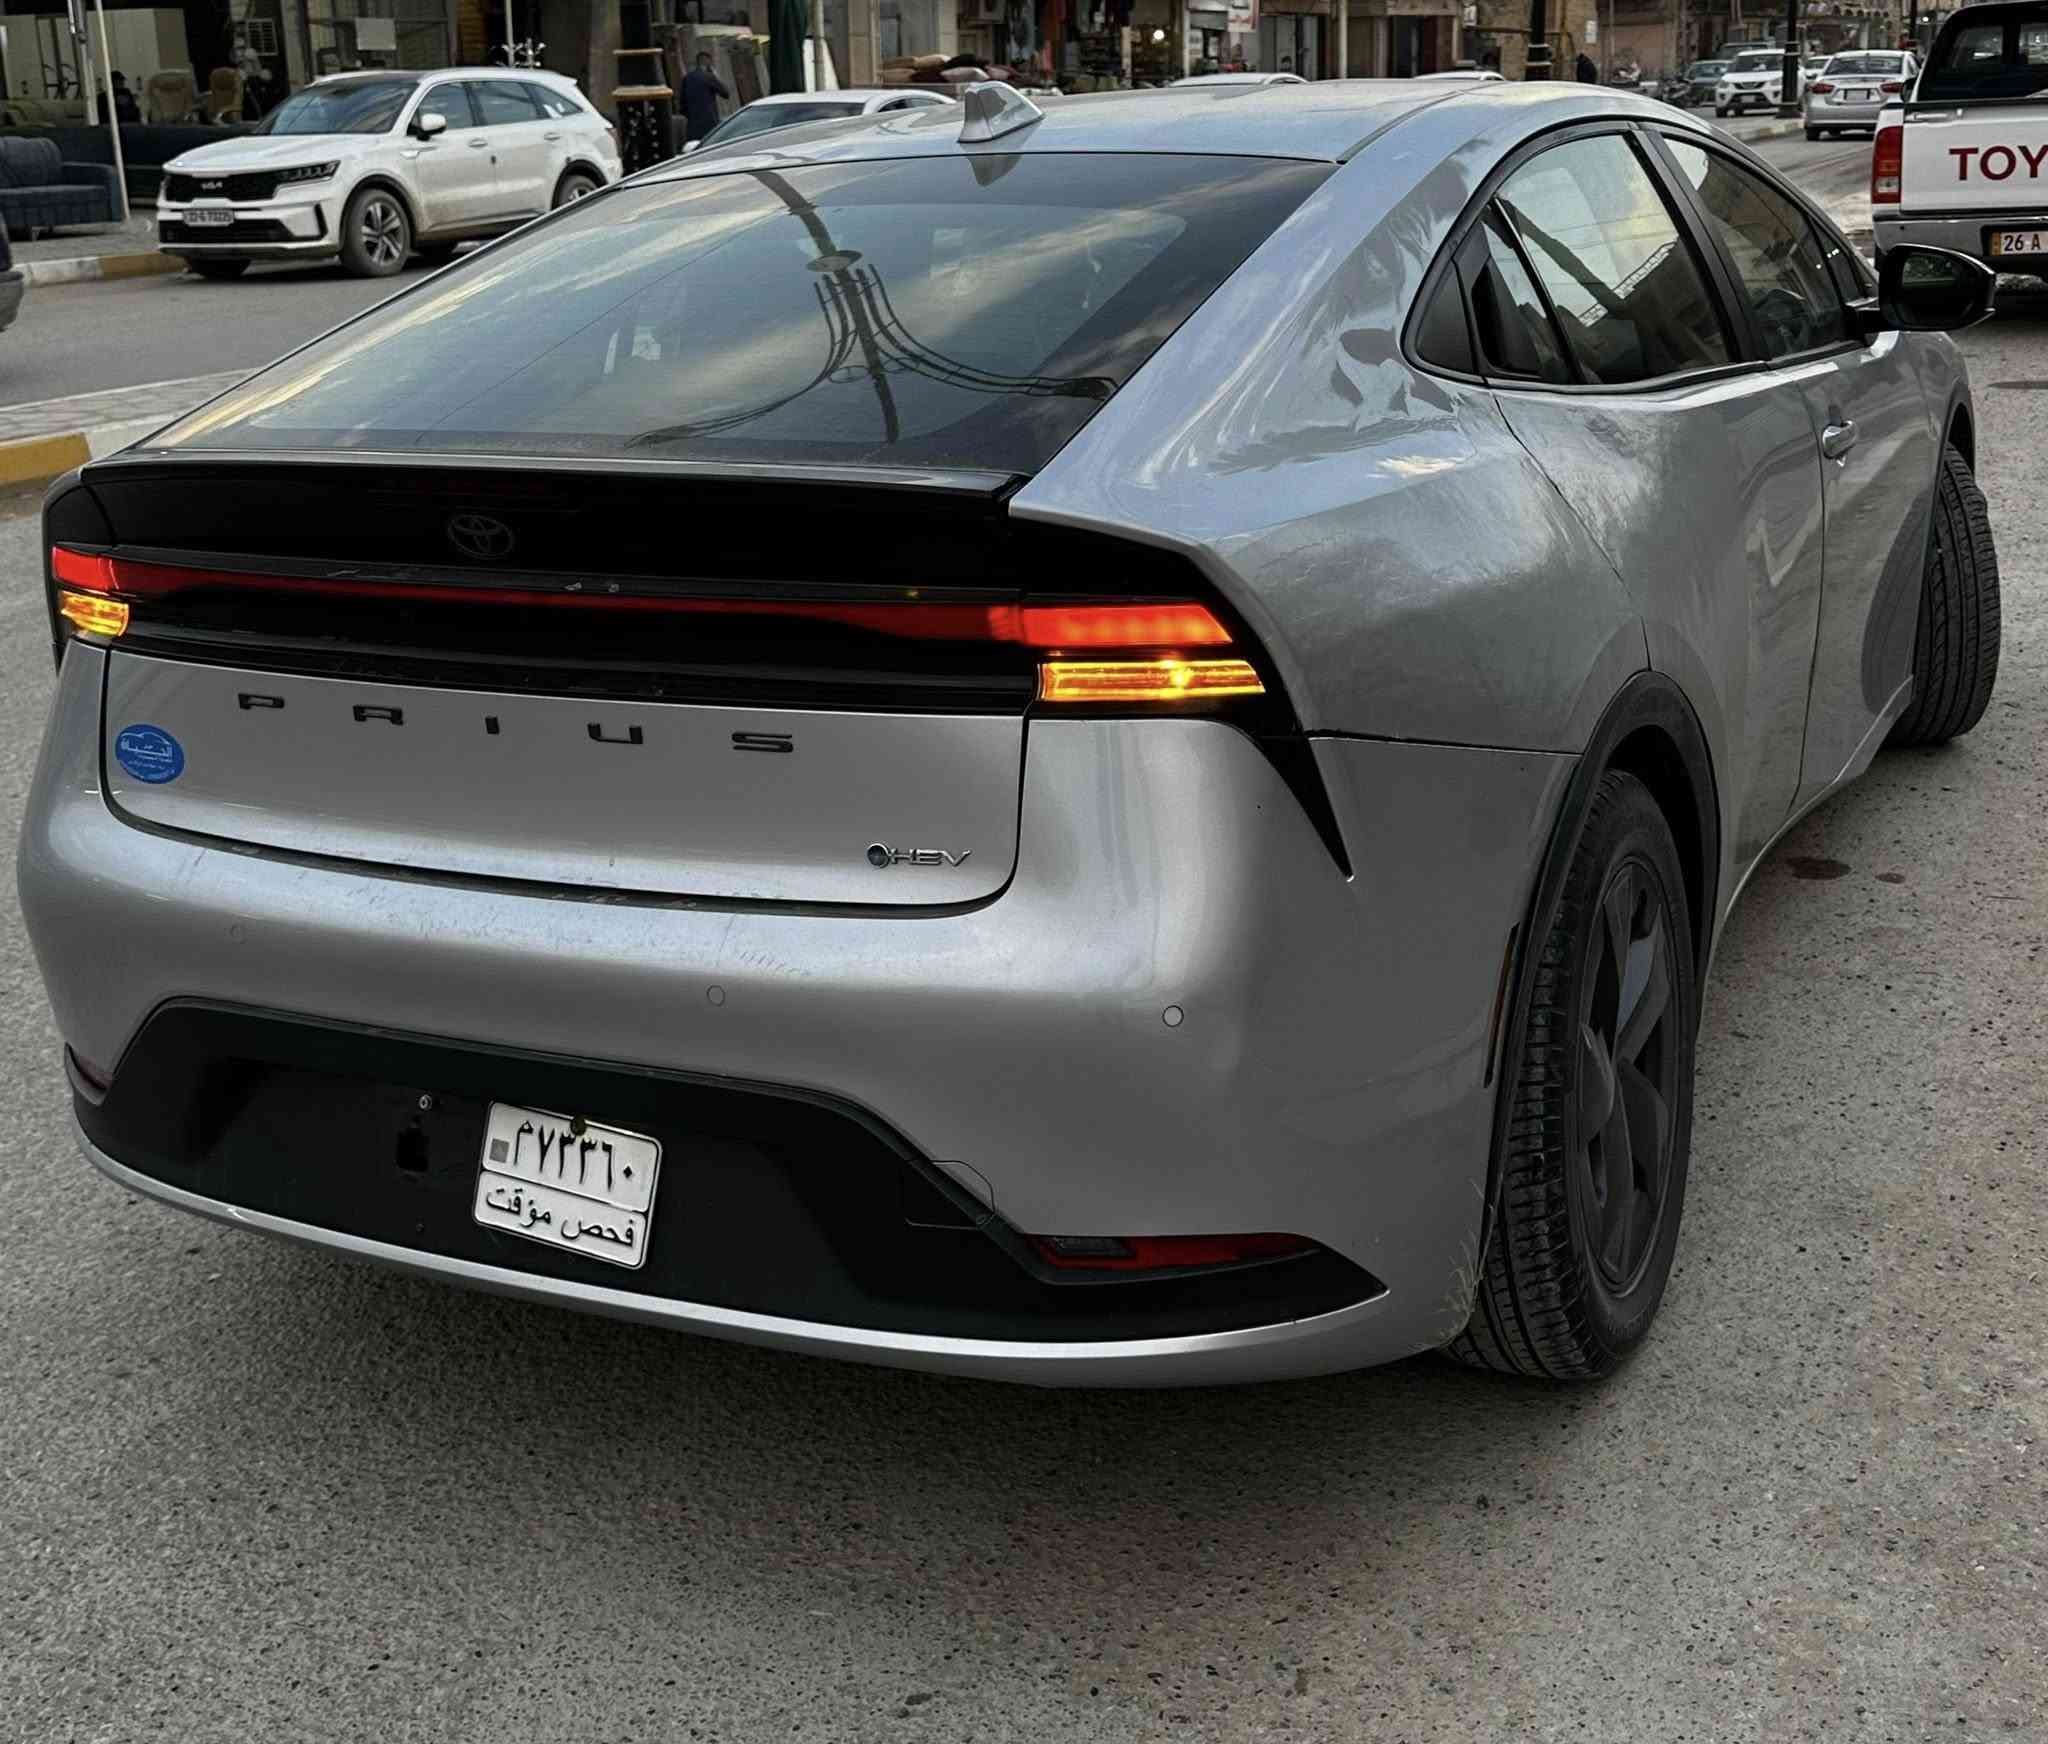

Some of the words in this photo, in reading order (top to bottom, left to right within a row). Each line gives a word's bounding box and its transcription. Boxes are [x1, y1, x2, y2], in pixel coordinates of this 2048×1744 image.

[2004, 234, 2024, 251] 26
[2031, 233, 2041, 250] A
[238, 692, 794, 753] PRIUS
[486, 1187, 551, 1228] مؤقت
[561, 1219, 634, 1247] فحص
